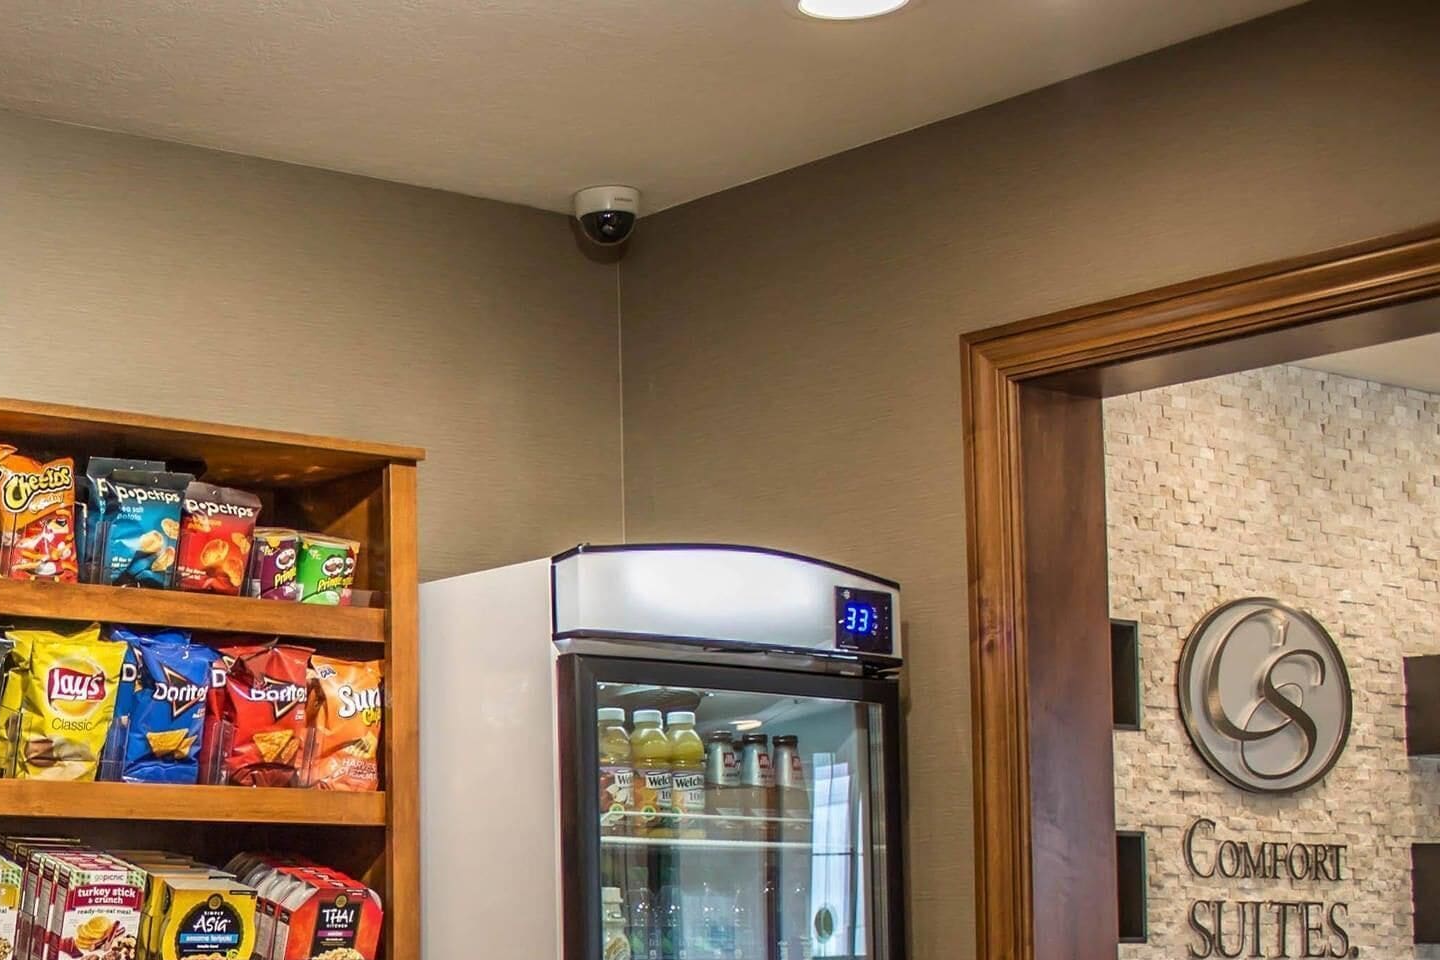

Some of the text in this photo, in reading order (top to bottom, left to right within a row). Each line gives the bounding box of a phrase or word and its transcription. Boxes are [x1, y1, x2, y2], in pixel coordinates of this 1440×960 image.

[3, 465, 73, 512] Cheetos
[117, 485, 180, 504] popchips
[184, 498, 255, 519] popchips
[845, 606, 869, 632] 33
[50, 667, 106, 700] Lay's
[51, 717, 93, 731] Classic
[1183, 818, 1348, 882] COMFORT
[78, 886, 136, 899] turkey stick
[95, 896, 124, 905] crunch
[193, 915, 227, 933] Asia
[322, 908, 354, 924] THAI
